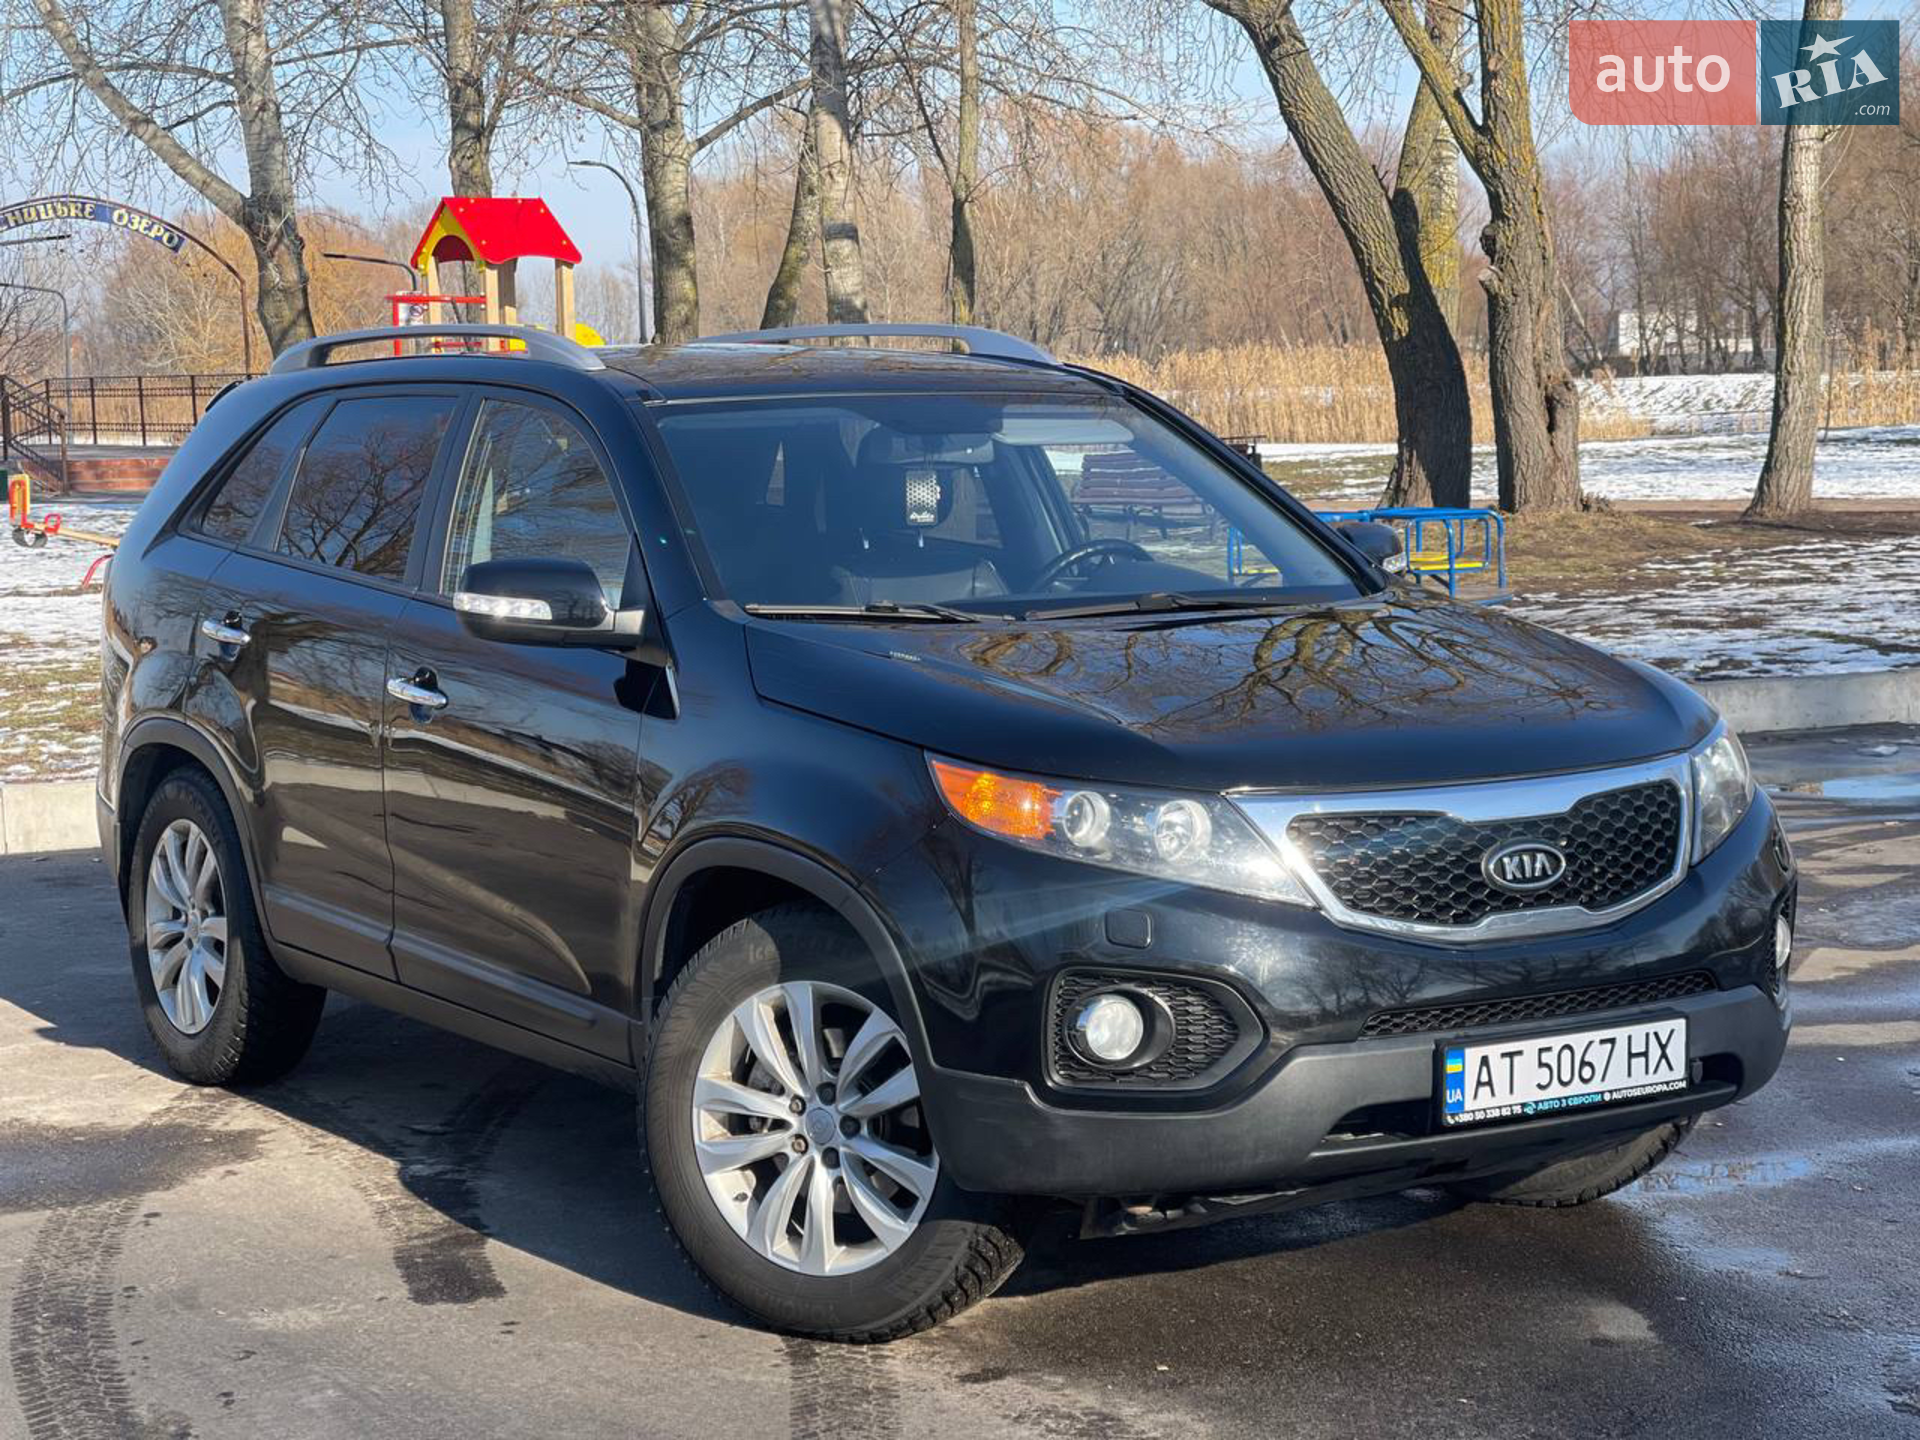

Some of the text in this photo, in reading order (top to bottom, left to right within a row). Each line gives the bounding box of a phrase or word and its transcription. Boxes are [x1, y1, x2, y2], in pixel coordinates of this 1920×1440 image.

[1502, 852, 1553, 880] KIA
[1473, 1028, 1676, 1101] AT 5067 HX
[1446, 1089, 1463, 1104] UA
[1612, 1080, 1687, 1100] AUTOSEUROPA.COM
[1537, 1099, 1560, 1111] АВТО
